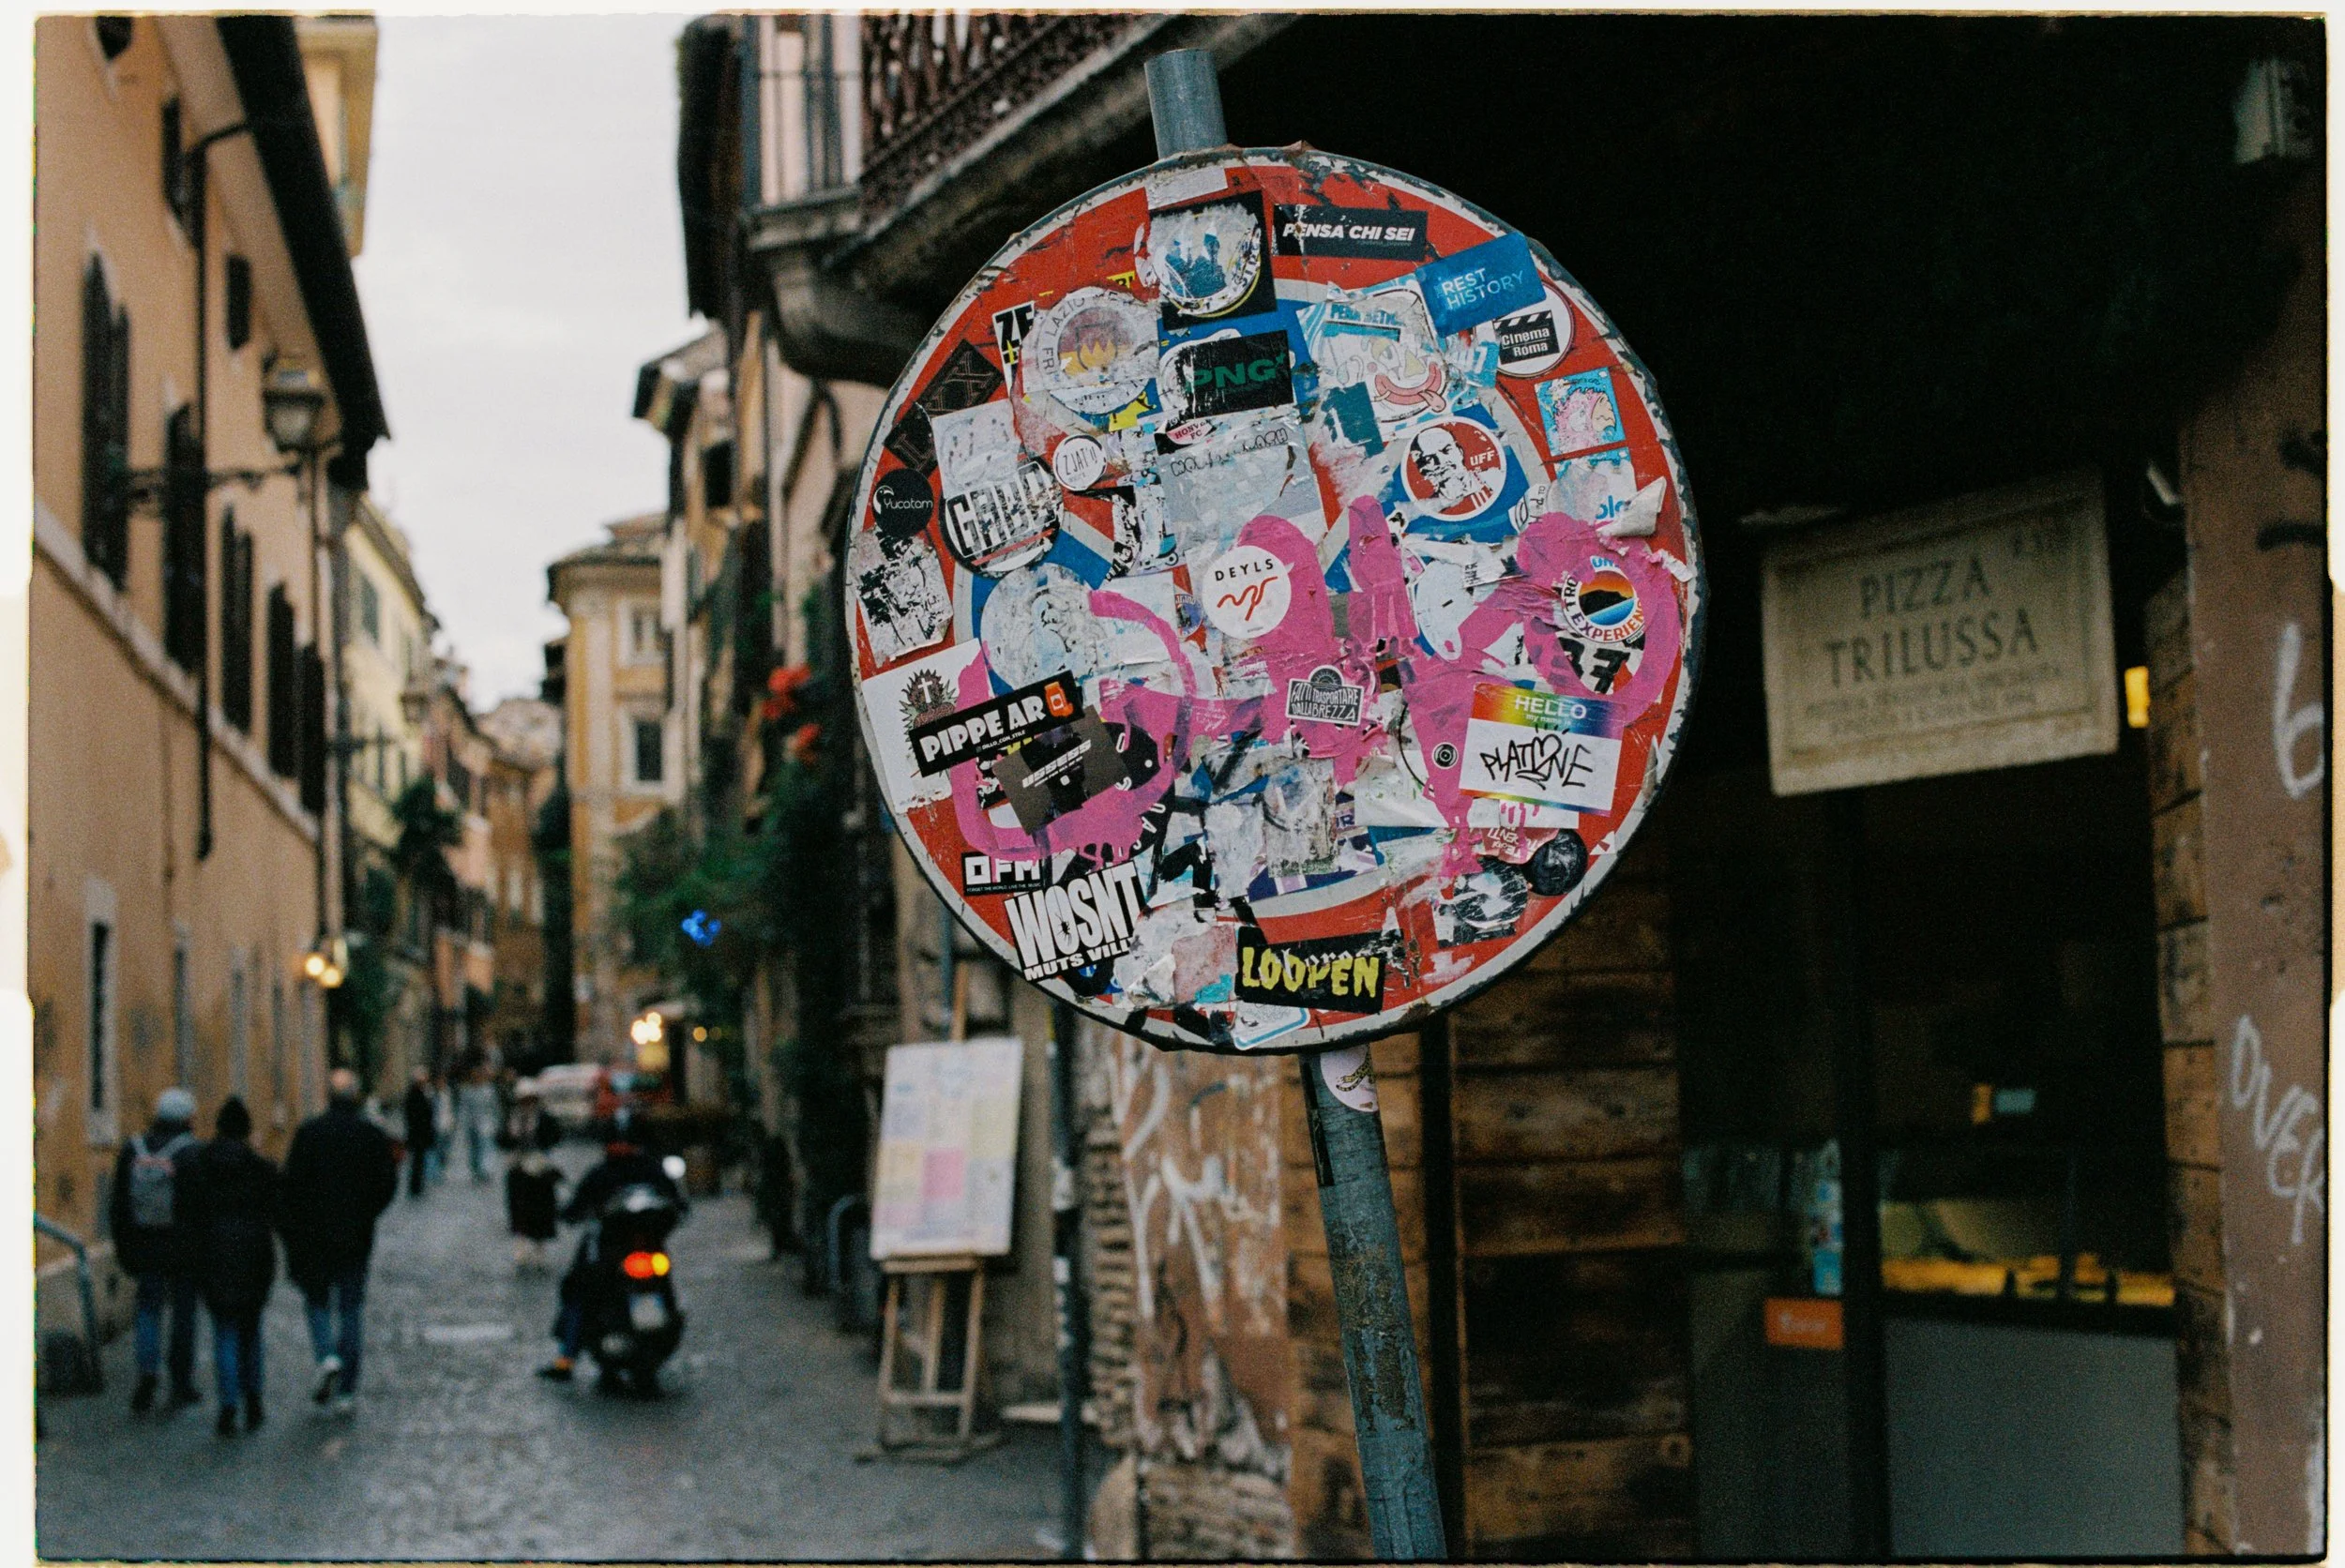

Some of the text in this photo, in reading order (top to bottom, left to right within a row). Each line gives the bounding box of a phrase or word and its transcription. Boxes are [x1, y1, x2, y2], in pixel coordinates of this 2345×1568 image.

[1282, 223, 1415, 241] PENSA CHI SEI
[1442, 267, 1486, 295] REST
[1446, 270, 1524, 310] HISTORY
[1190, 430, 1203, 441] FC
[1215, 559, 1273, 580] DEYLS
[1860, 555, 1991, 620] PIZZA
[1824, 607, 2038, 688] TRILUSSA
[1291, 683, 1358, 705] FATTI TRASPORTARE
[1515, 695, 1586, 719] HELLO
[1291, 701, 1356, 721] DALLA BREZZA
[919, 696, 1048, 761] PIPPE AR
[965, 854, 1041, 885] OFM
[1024, 939, 1133, 981] MUTS VILL
